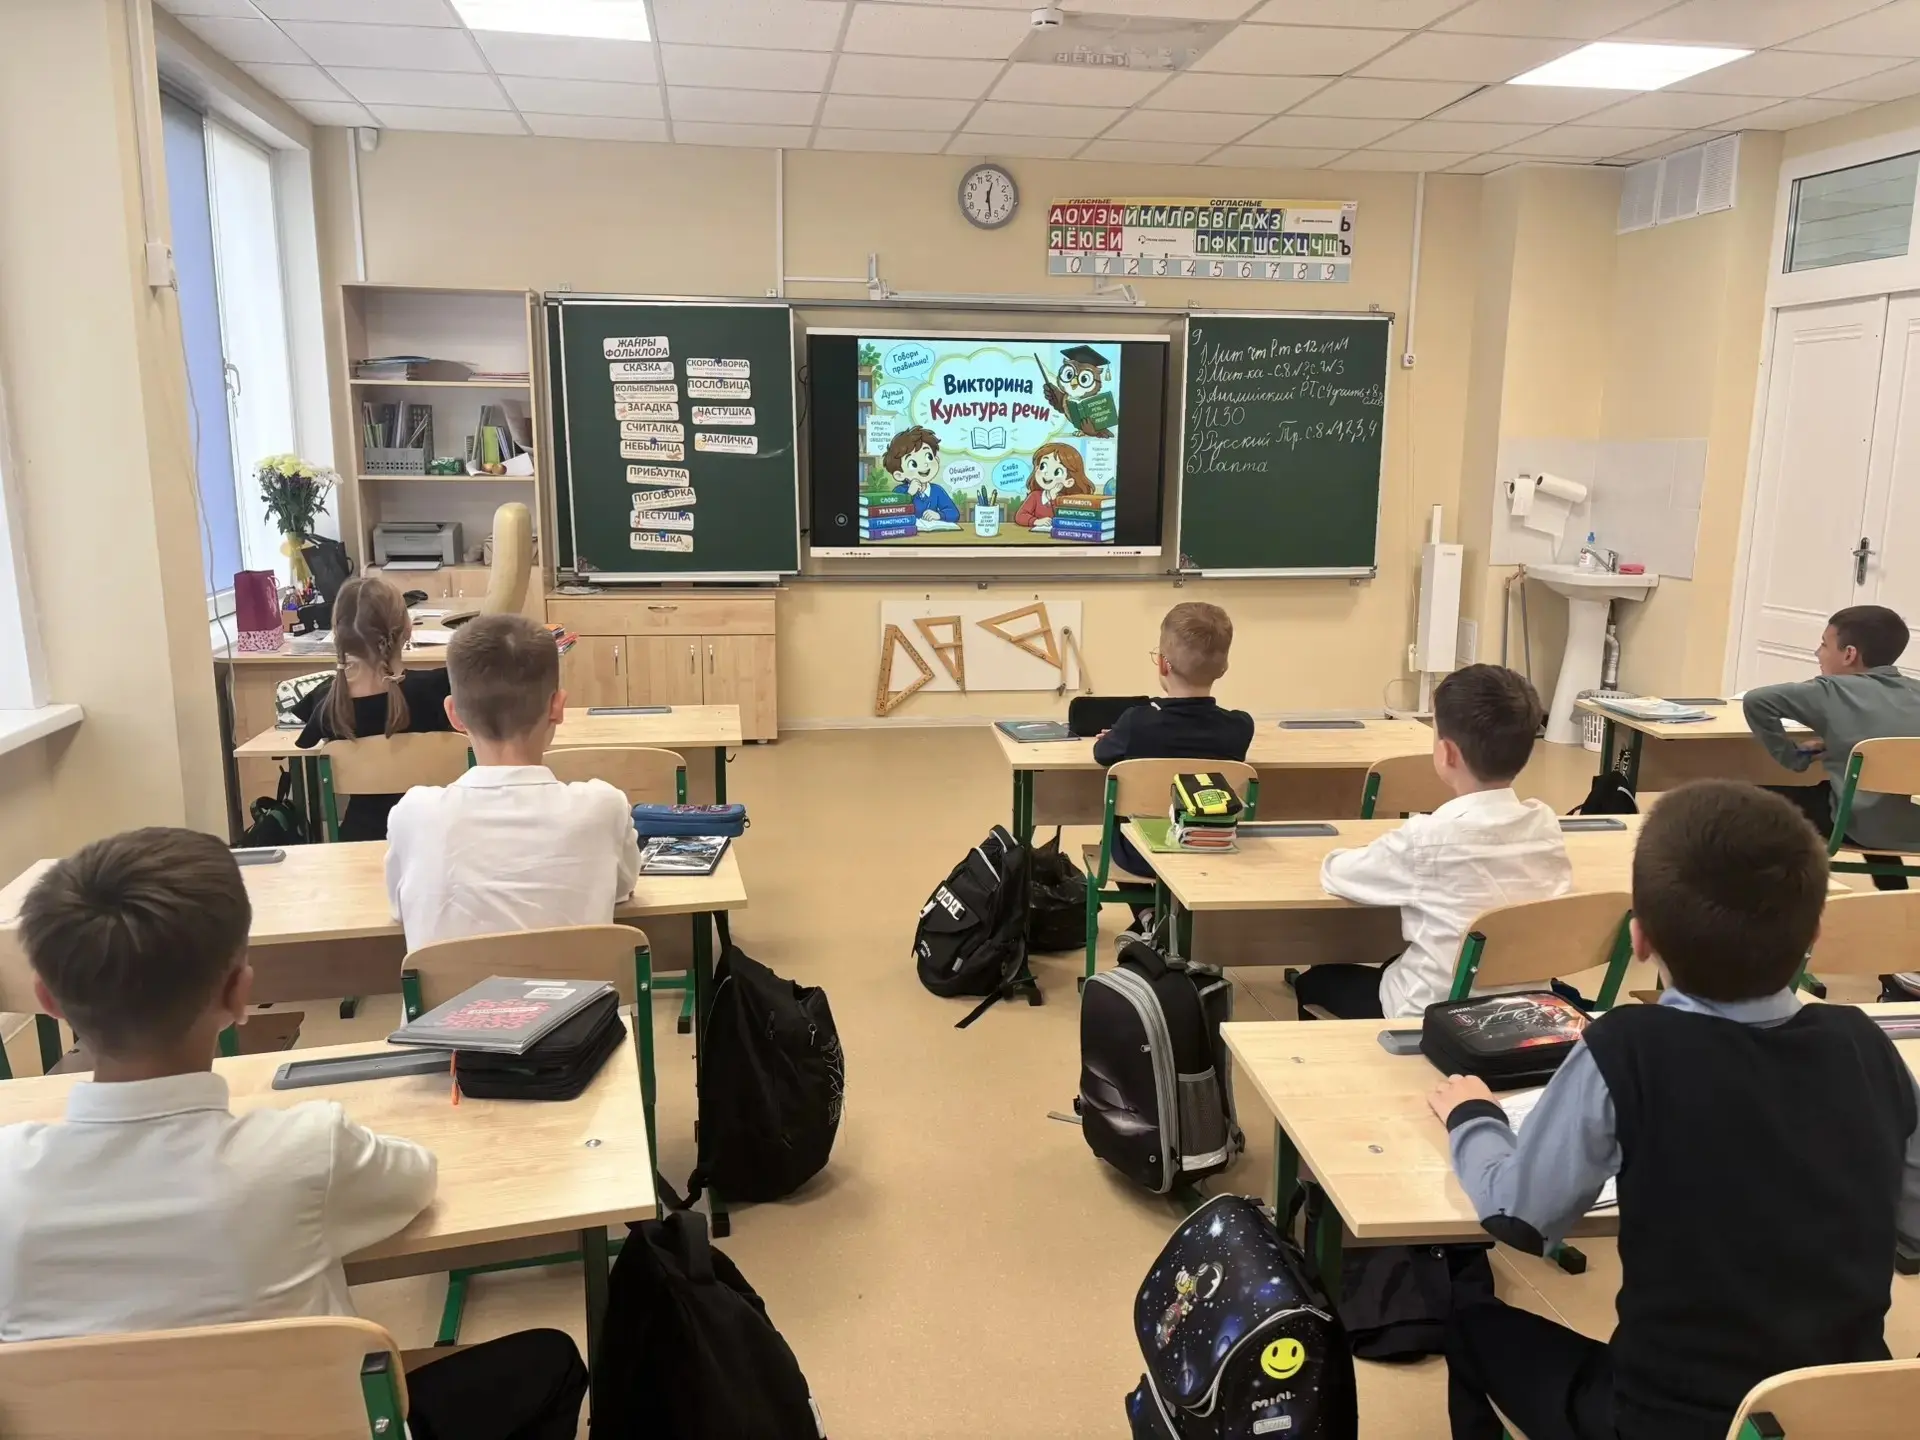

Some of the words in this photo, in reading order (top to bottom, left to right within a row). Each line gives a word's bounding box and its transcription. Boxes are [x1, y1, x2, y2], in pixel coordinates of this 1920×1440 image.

[970, 183, 977, 191] 10
[1001, 185, 1006, 193] 2
[967, 192, 972, 200] 9
[1003, 194, 1009, 202] 3
[969, 201, 974, 210] 8
[1210, 199, 1262, 207] СОГЛАСНЫЕ
[976, 209, 981, 217] 7
[1071, 257, 1081, 273] 0
[1103, 257, 1111, 273] 1
[1128, 258, 1139, 275] 2
[1156, 259, 1168, 275] 3
[1187, 260, 1196, 276] 4
[1212, 261, 1224, 277] 5
[1241, 261, 1253, 278] 6
[1269, 262, 1281, 279] 7
[1297, 263, 1308, 279] 8
[1324, 263, 1336, 280] 9
[617, 338, 656, 348] ЖАНРЫ
[605, 347, 668, 358] ФОЛЬКЛОРА
[892, 350, 919, 363] Говори
[623, 362, 662, 372] СКАЗКА
[687, 359, 749, 368] СКОРОГОВОРКА
[892, 355, 929, 374] правильно!
[615, 384, 675, 393] КОЛЫБЕЛЬНАЯ
[688, 380, 749, 390] ПОСЛОВИЦА
[943, 374, 1033, 398] Викторина
[881, 388, 904, 400] Думай
[887, 396, 904, 406] ясно!
[627, 403, 672, 413] ЗАГАДКА
[697, 407, 752, 416] ЧАСТУШКА
[930, 398, 1007, 424] Культура
[1012, 402, 1050, 423] речи
[626, 422, 679, 433] СЧИТАЛКА
[702, 434, 753, 445] ЗАКЛИЧКА
[624, 441, 681, 453] НЕБЫЛИЦА
[629, 467, 687, 479] ПРИБАУТКА
[949, 465, 975, 475] Общайся
[950, 472, 980, 484] культурно!
[634, 488, 694, 502] ПОГОВОРКА
